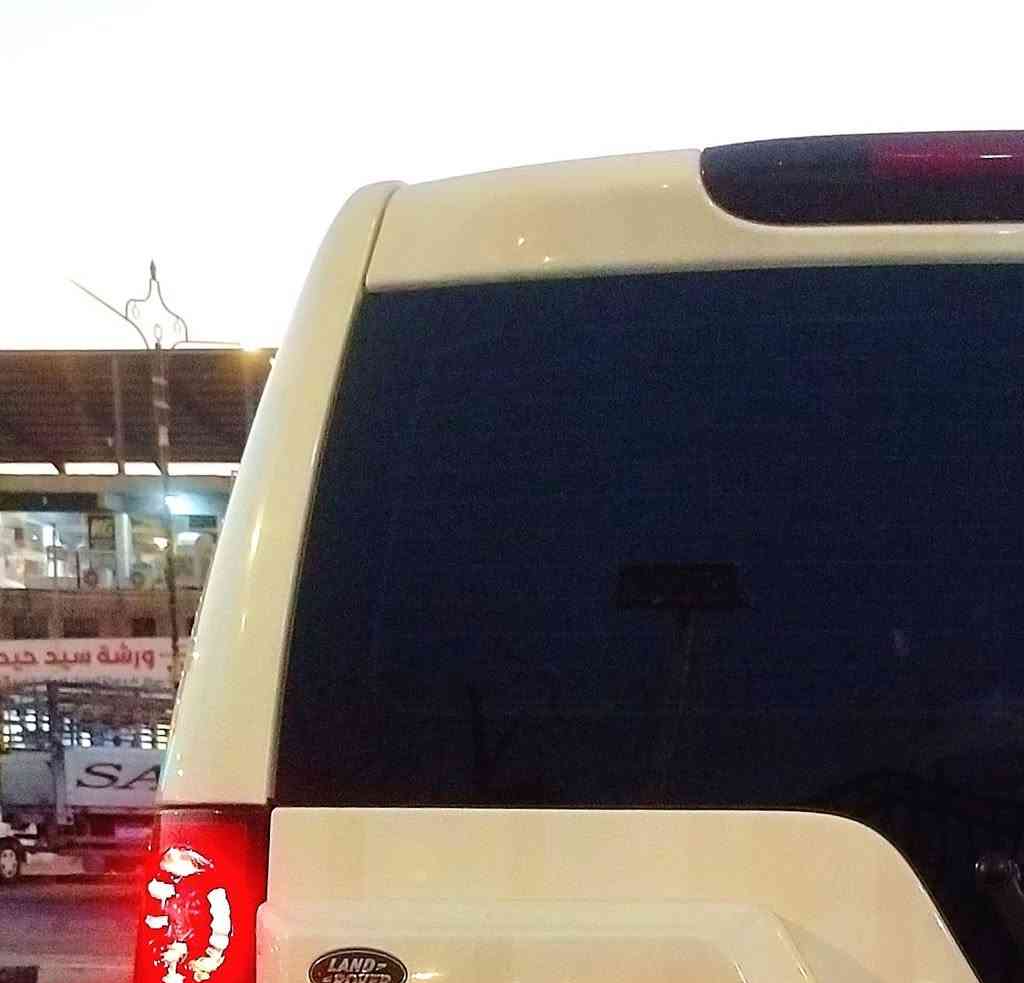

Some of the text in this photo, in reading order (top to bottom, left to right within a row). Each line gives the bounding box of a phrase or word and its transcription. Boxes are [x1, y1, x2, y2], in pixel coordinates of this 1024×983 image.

[44, 650, 92, 670] سيد
[96, 642, 156, 669] ورشة
[328, 958, 376, 973] LAND
